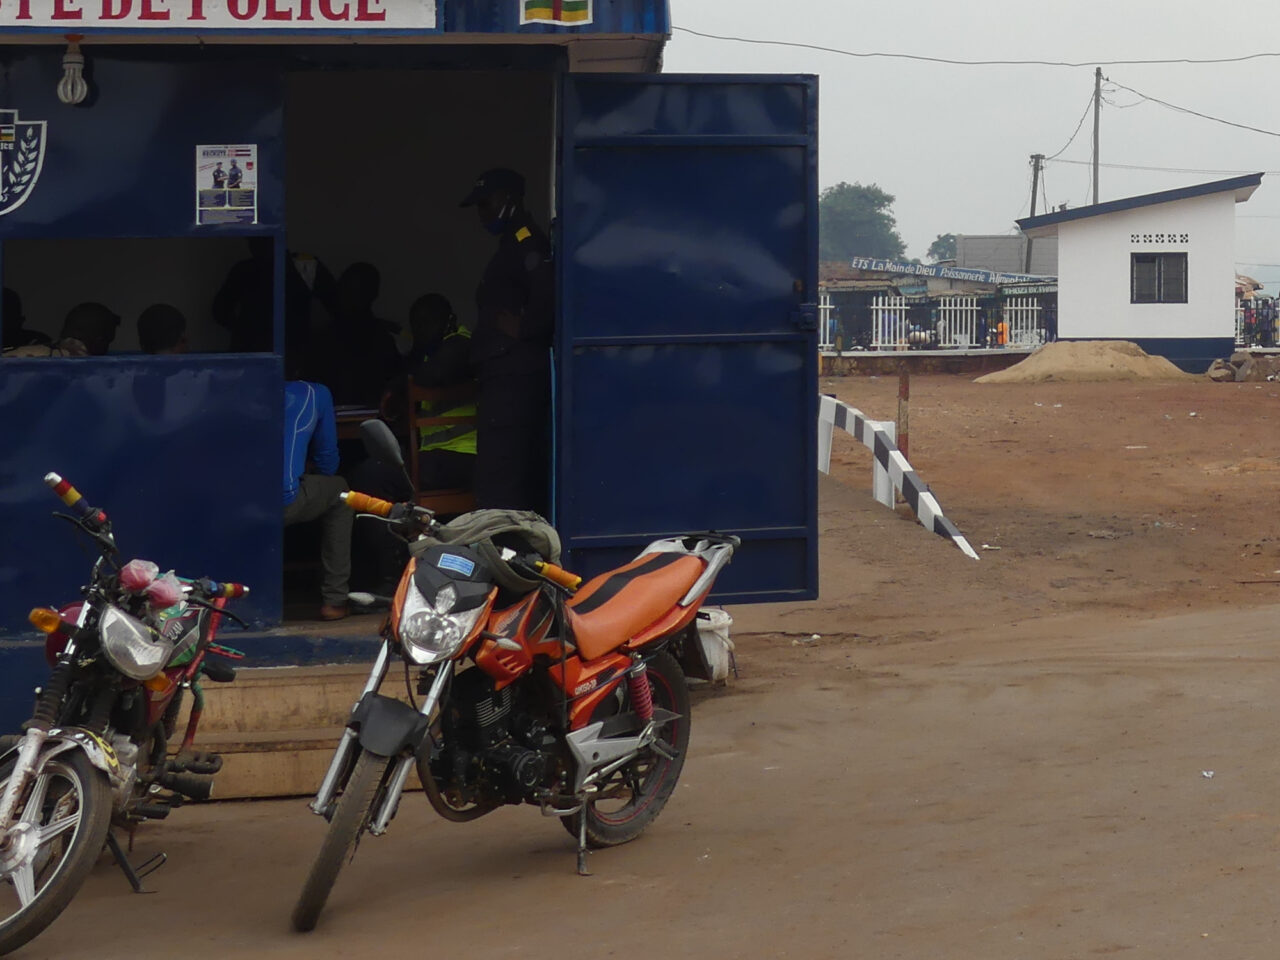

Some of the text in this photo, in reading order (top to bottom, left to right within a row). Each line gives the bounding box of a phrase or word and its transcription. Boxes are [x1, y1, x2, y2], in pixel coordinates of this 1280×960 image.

[852, 258, 869, 270] ETS
[871, 259, 884, 271] La
[884, 259, 905, 273] Main
[905, 263, 915, 274] de
[915, 264, 936, 276] Dieu
